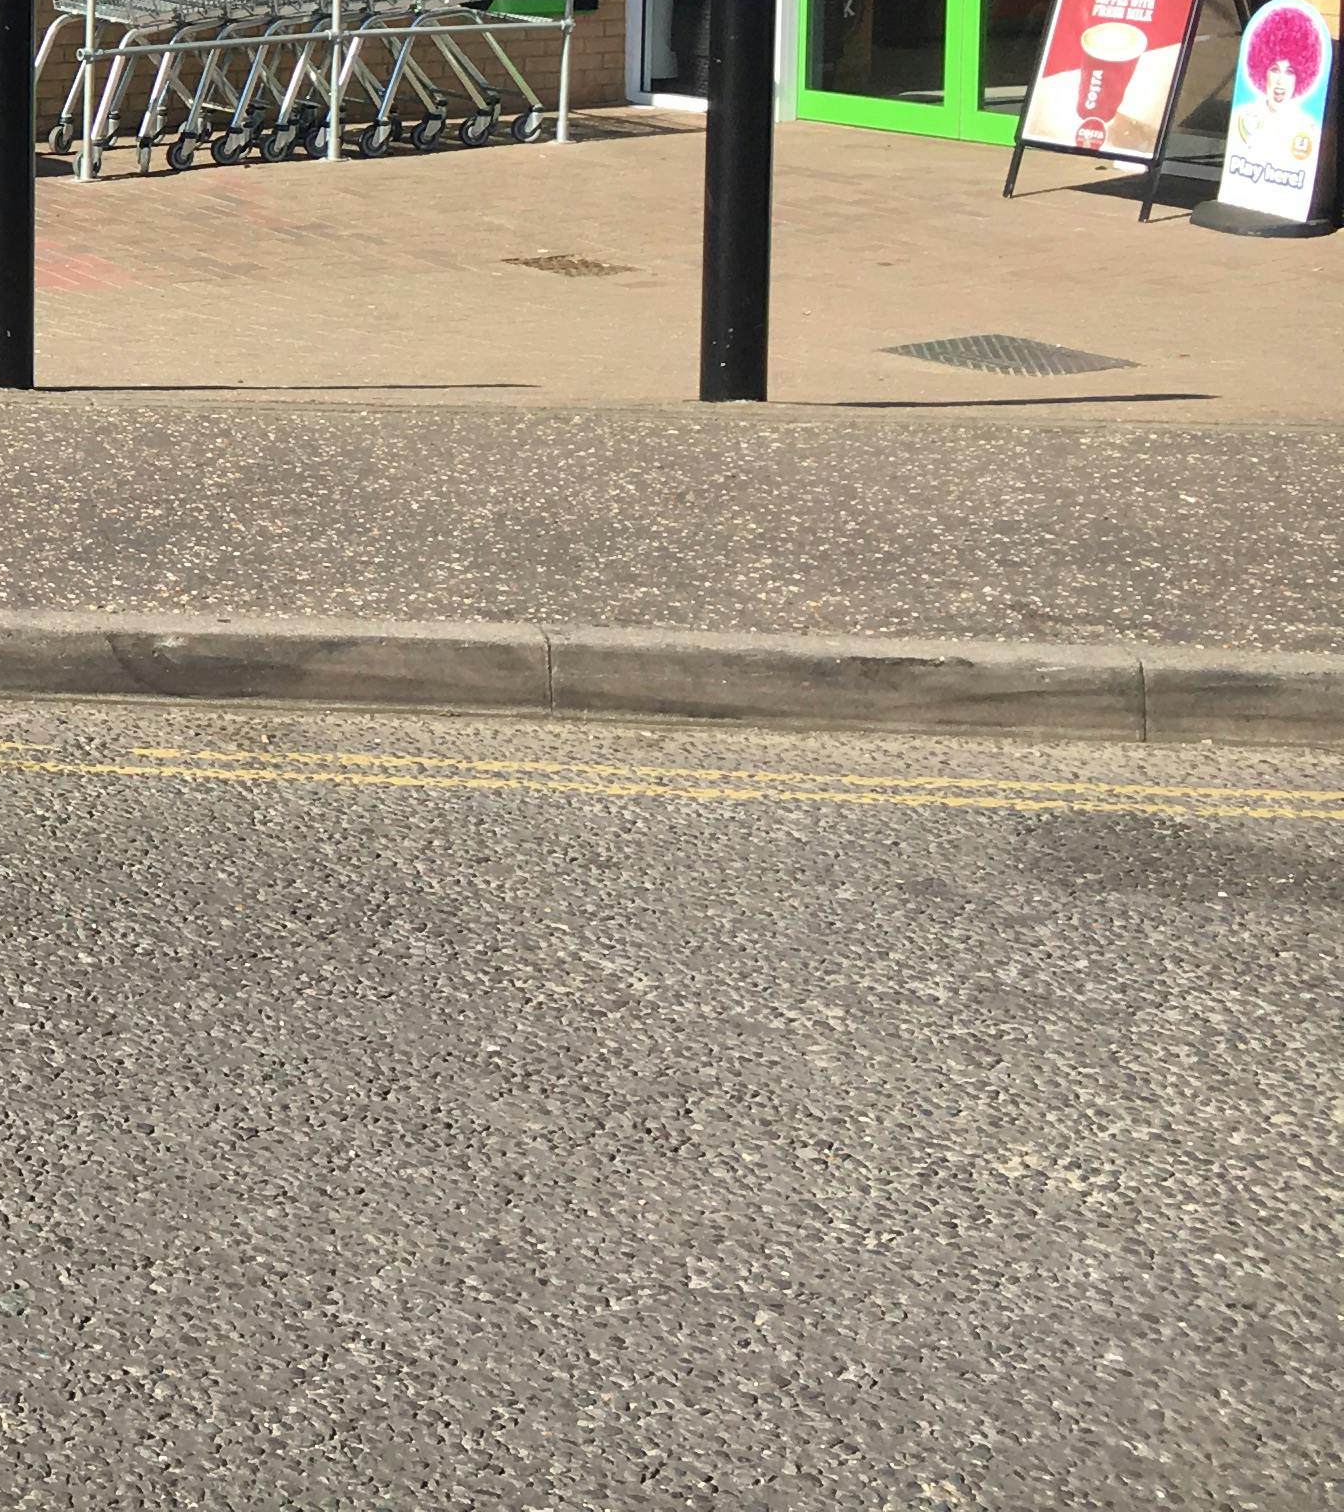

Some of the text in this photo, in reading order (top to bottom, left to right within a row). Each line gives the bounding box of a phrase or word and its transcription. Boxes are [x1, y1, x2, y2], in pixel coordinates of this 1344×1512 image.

[1085, 69, 1104, 110] COSTA
[1229, 155, 1305, 189] Play here!
